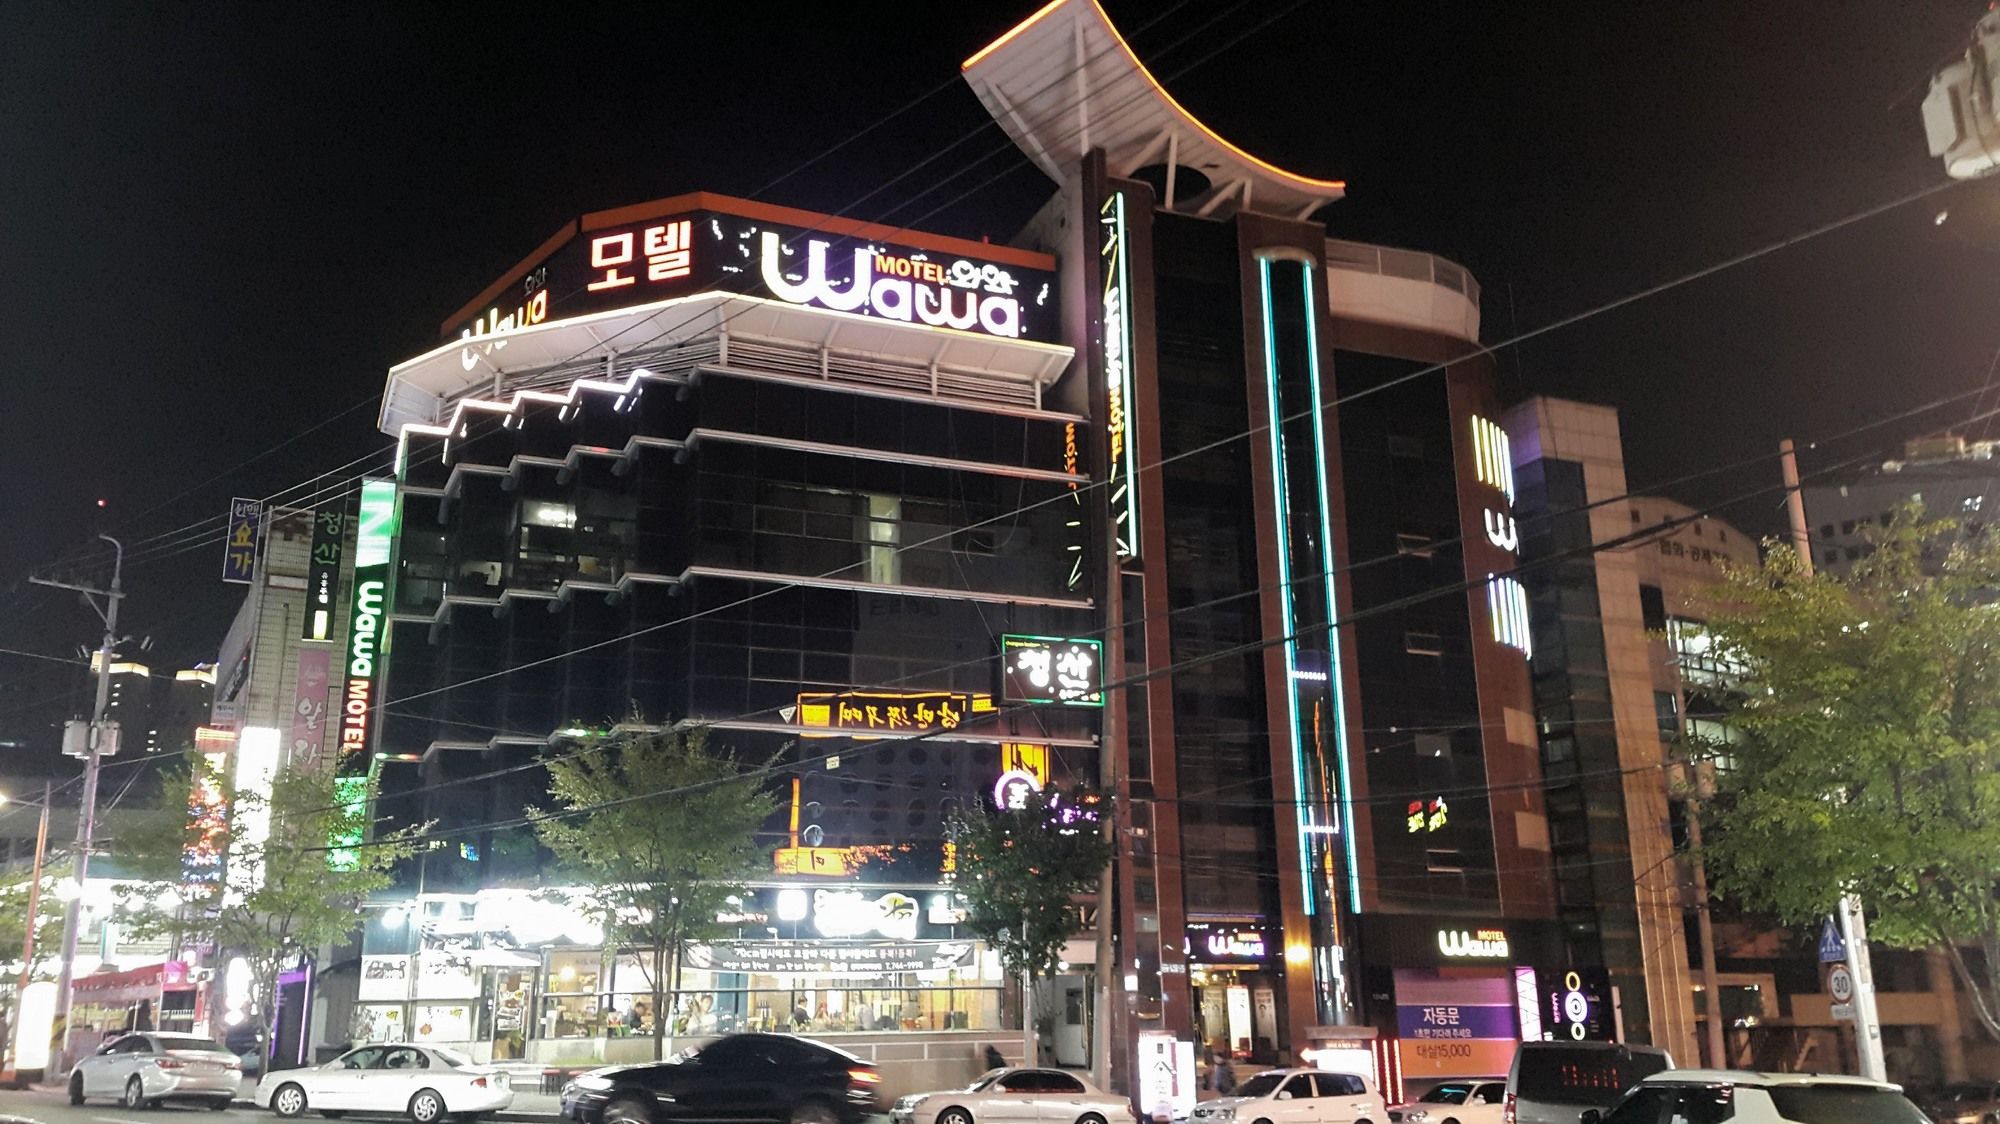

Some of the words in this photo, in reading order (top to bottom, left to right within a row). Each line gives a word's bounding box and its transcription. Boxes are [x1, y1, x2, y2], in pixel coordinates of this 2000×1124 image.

[588, 220, 692, 291] 모텔
[876, 255, 950, 284] MOTEL
[230, 520, 254, 577] 요가
[343, 680, 370, 752] MOTEL
[1477, 930, 1506, 941] MOTEL
[1833, 976, 1849, 993] 30
[1423, 1006, 1460, 1025] 자동문
[1452, 1028, 1473, 1039] 주세요
